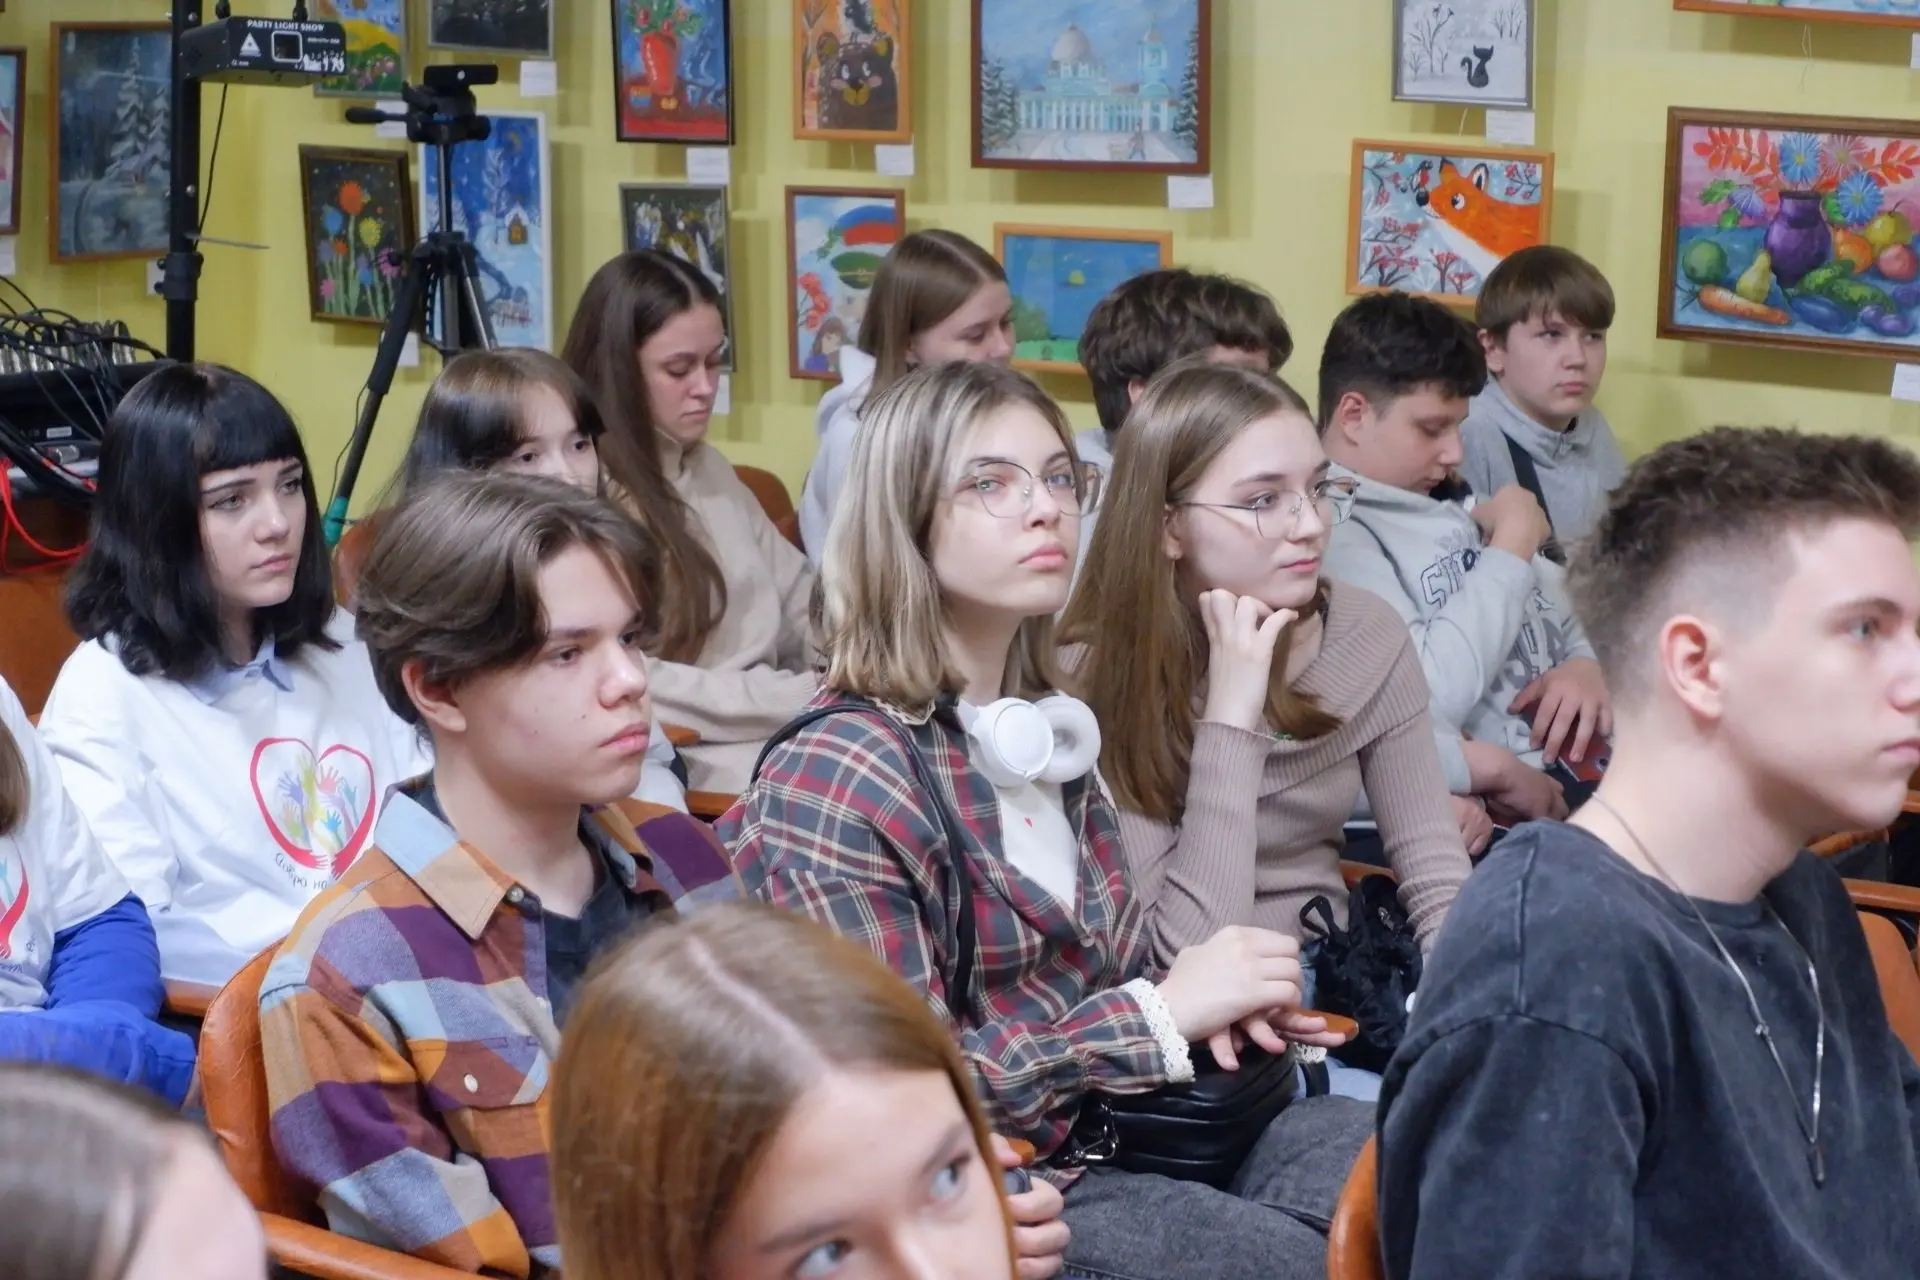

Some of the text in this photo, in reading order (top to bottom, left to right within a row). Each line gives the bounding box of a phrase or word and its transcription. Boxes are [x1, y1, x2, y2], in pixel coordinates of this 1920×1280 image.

[248, 19, 324, 32] PARTY LIGHT SHOW
